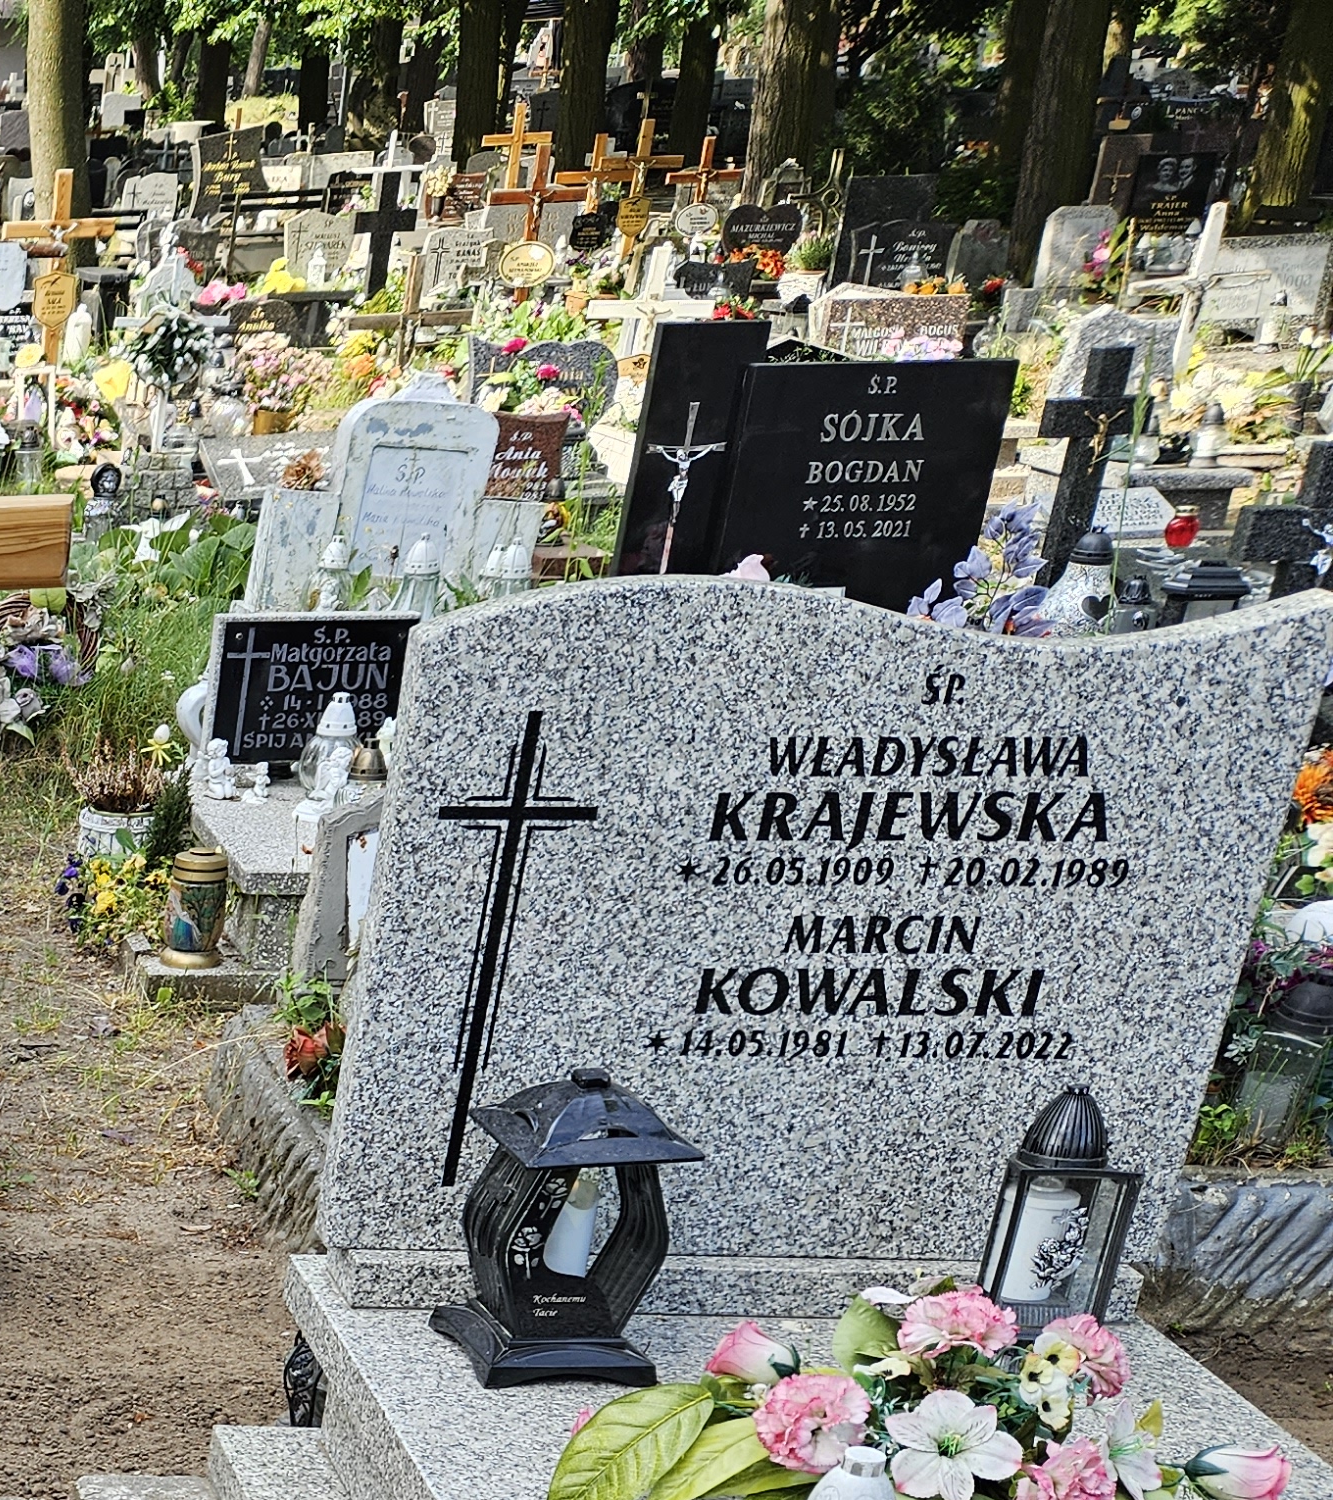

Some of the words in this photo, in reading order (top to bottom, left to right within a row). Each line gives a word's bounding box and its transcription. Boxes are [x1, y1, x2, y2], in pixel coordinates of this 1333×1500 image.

[1150, 201, 1188, 210] TRAJER
[730, 223, 796, 234] MAZURKIEWICZ
[820, 410, 925, 443] SÓJKA
[496, 444, 542, 460] Ania
[805, 459, 925, 484] BOGDAN
[269, 641, 392, 671] Małgorzata
[267, 663, 389, 692] BAJUN
[767, 736, 1089, 778] WŁADYSŁAWA
[709, 791, 1109, 850] KRAJEWSKA
[783, 914, 983, 955] MARCIN
[694, 967, 1045, 1018] KOWALSKI
